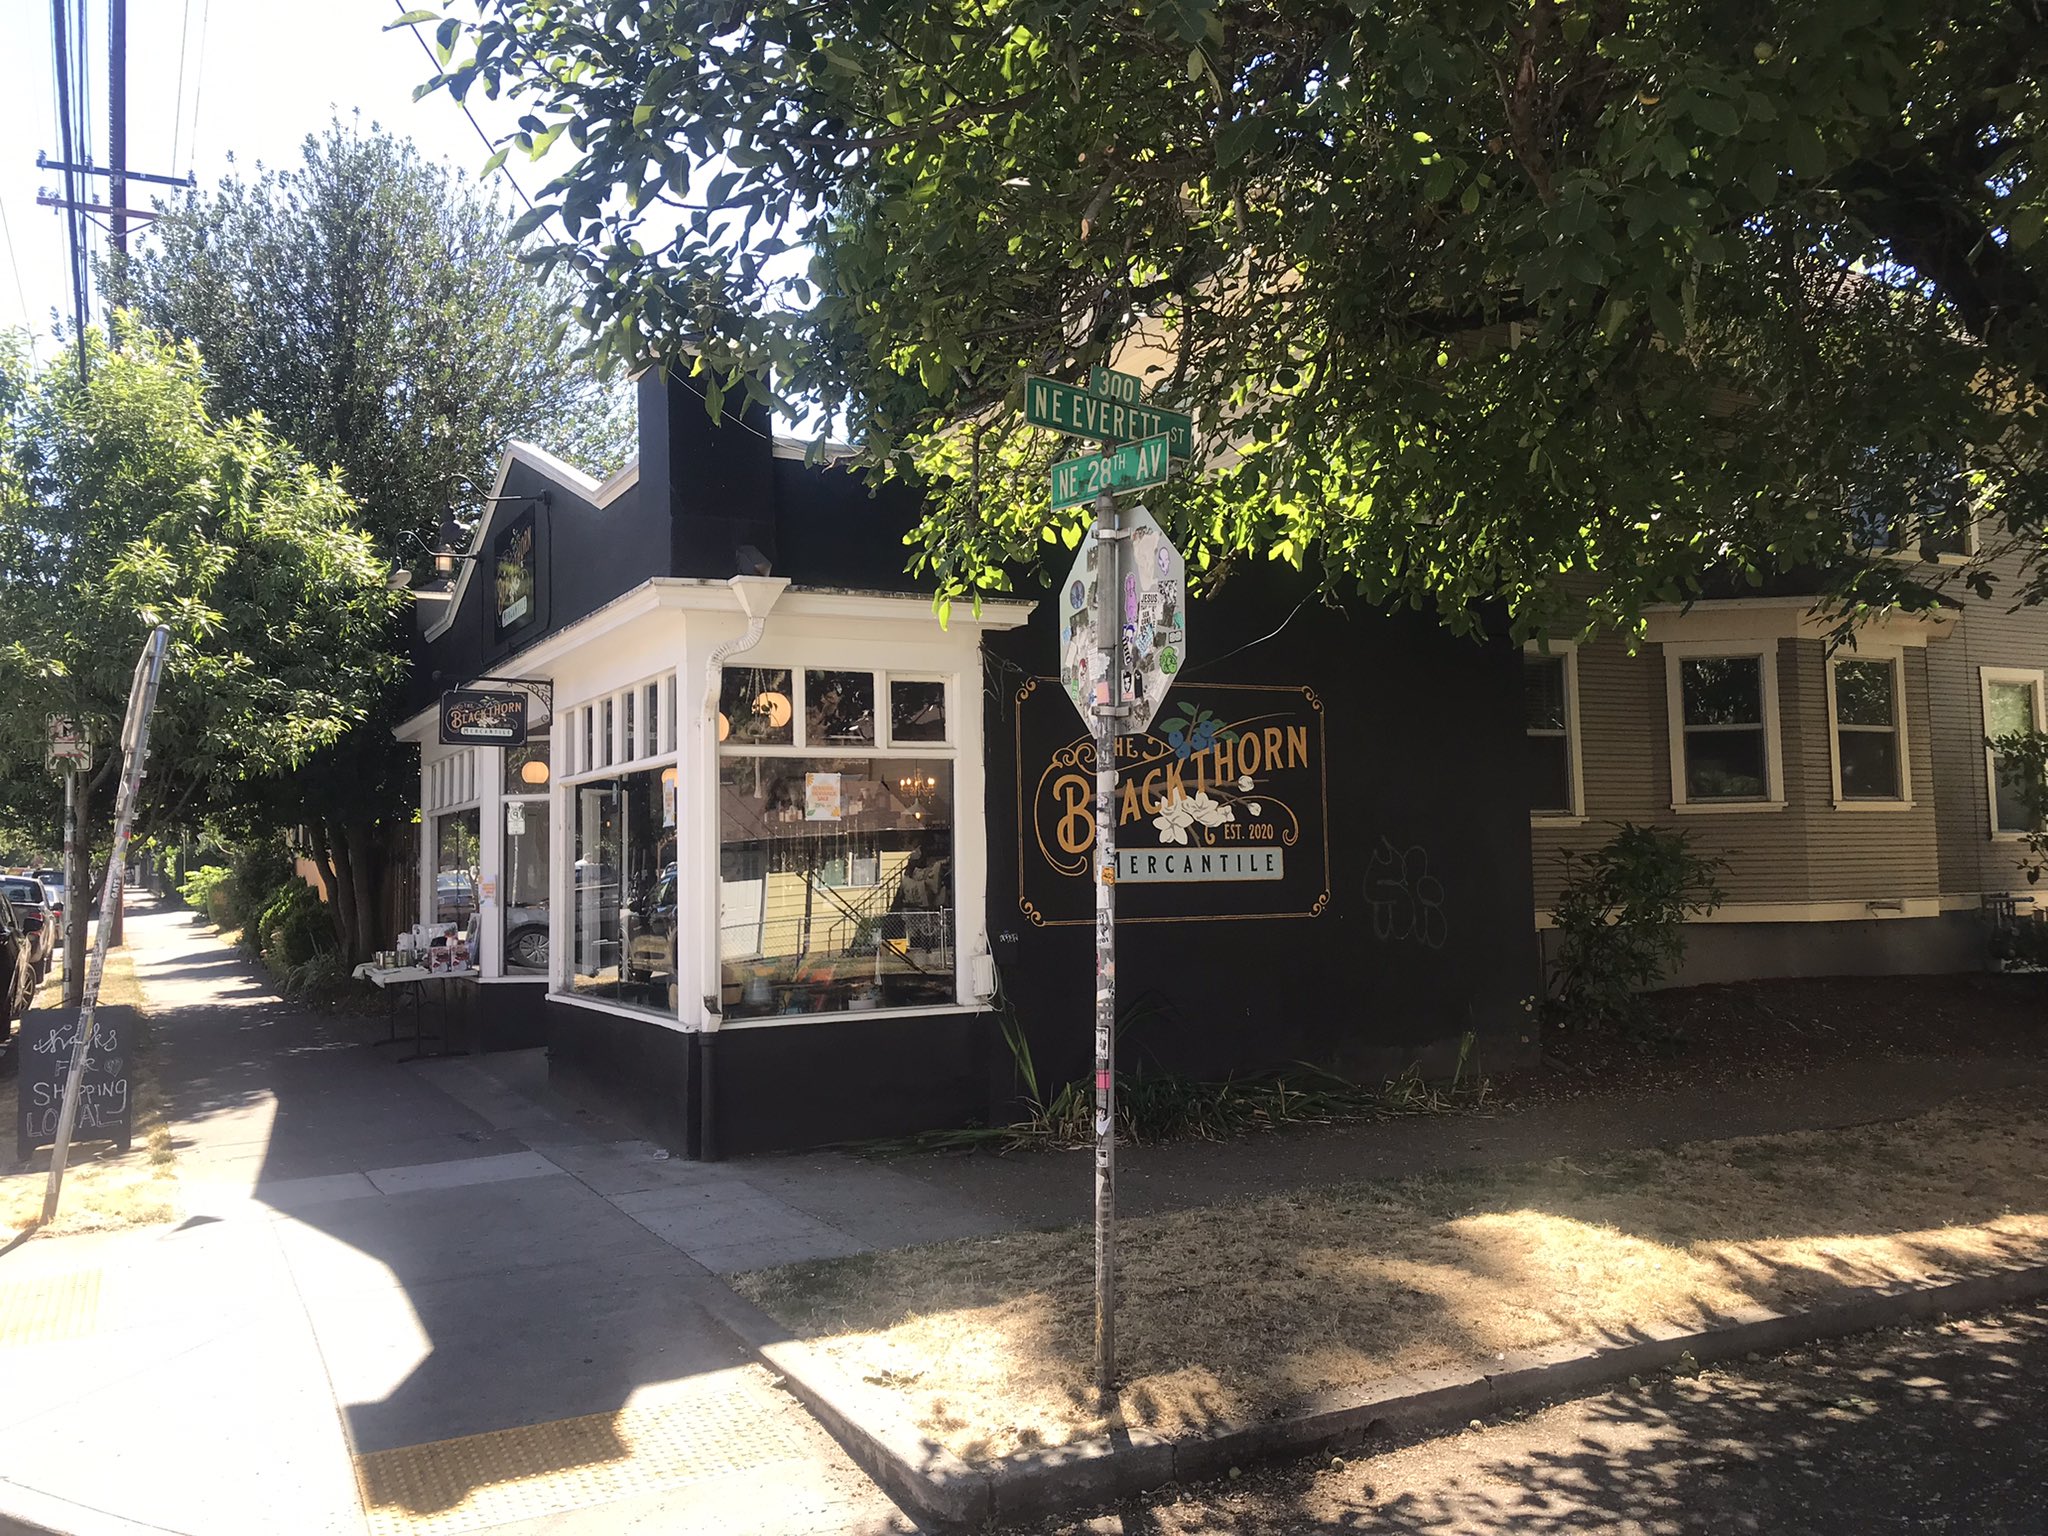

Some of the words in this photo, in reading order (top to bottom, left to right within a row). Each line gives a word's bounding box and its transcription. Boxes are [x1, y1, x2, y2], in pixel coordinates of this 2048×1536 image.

[1098, 371, 1134, 403] 300
[1035, 385, 1063, 423] NE
[1072, 395, 1161, 440] EVERETT
[1170, 426, 1185, 444] ST
[1059, 466, 1078, 500] NE
[1087, 453, 1126, 493] 28TH
[1136, 443, 1163, 480] AV
[450, 702, 522, 729] BLACKTHORN
[1114, 737, 1139, 758] HE
[1053, 726, 1308, 853] BACKTHORN
[1224, 823, 1245, 840] EST.
[1248, 823, 1274, 840] 2020
[55, 1058, 99, 1077] FR
[26, 1103, 123, 1138] LOAL
